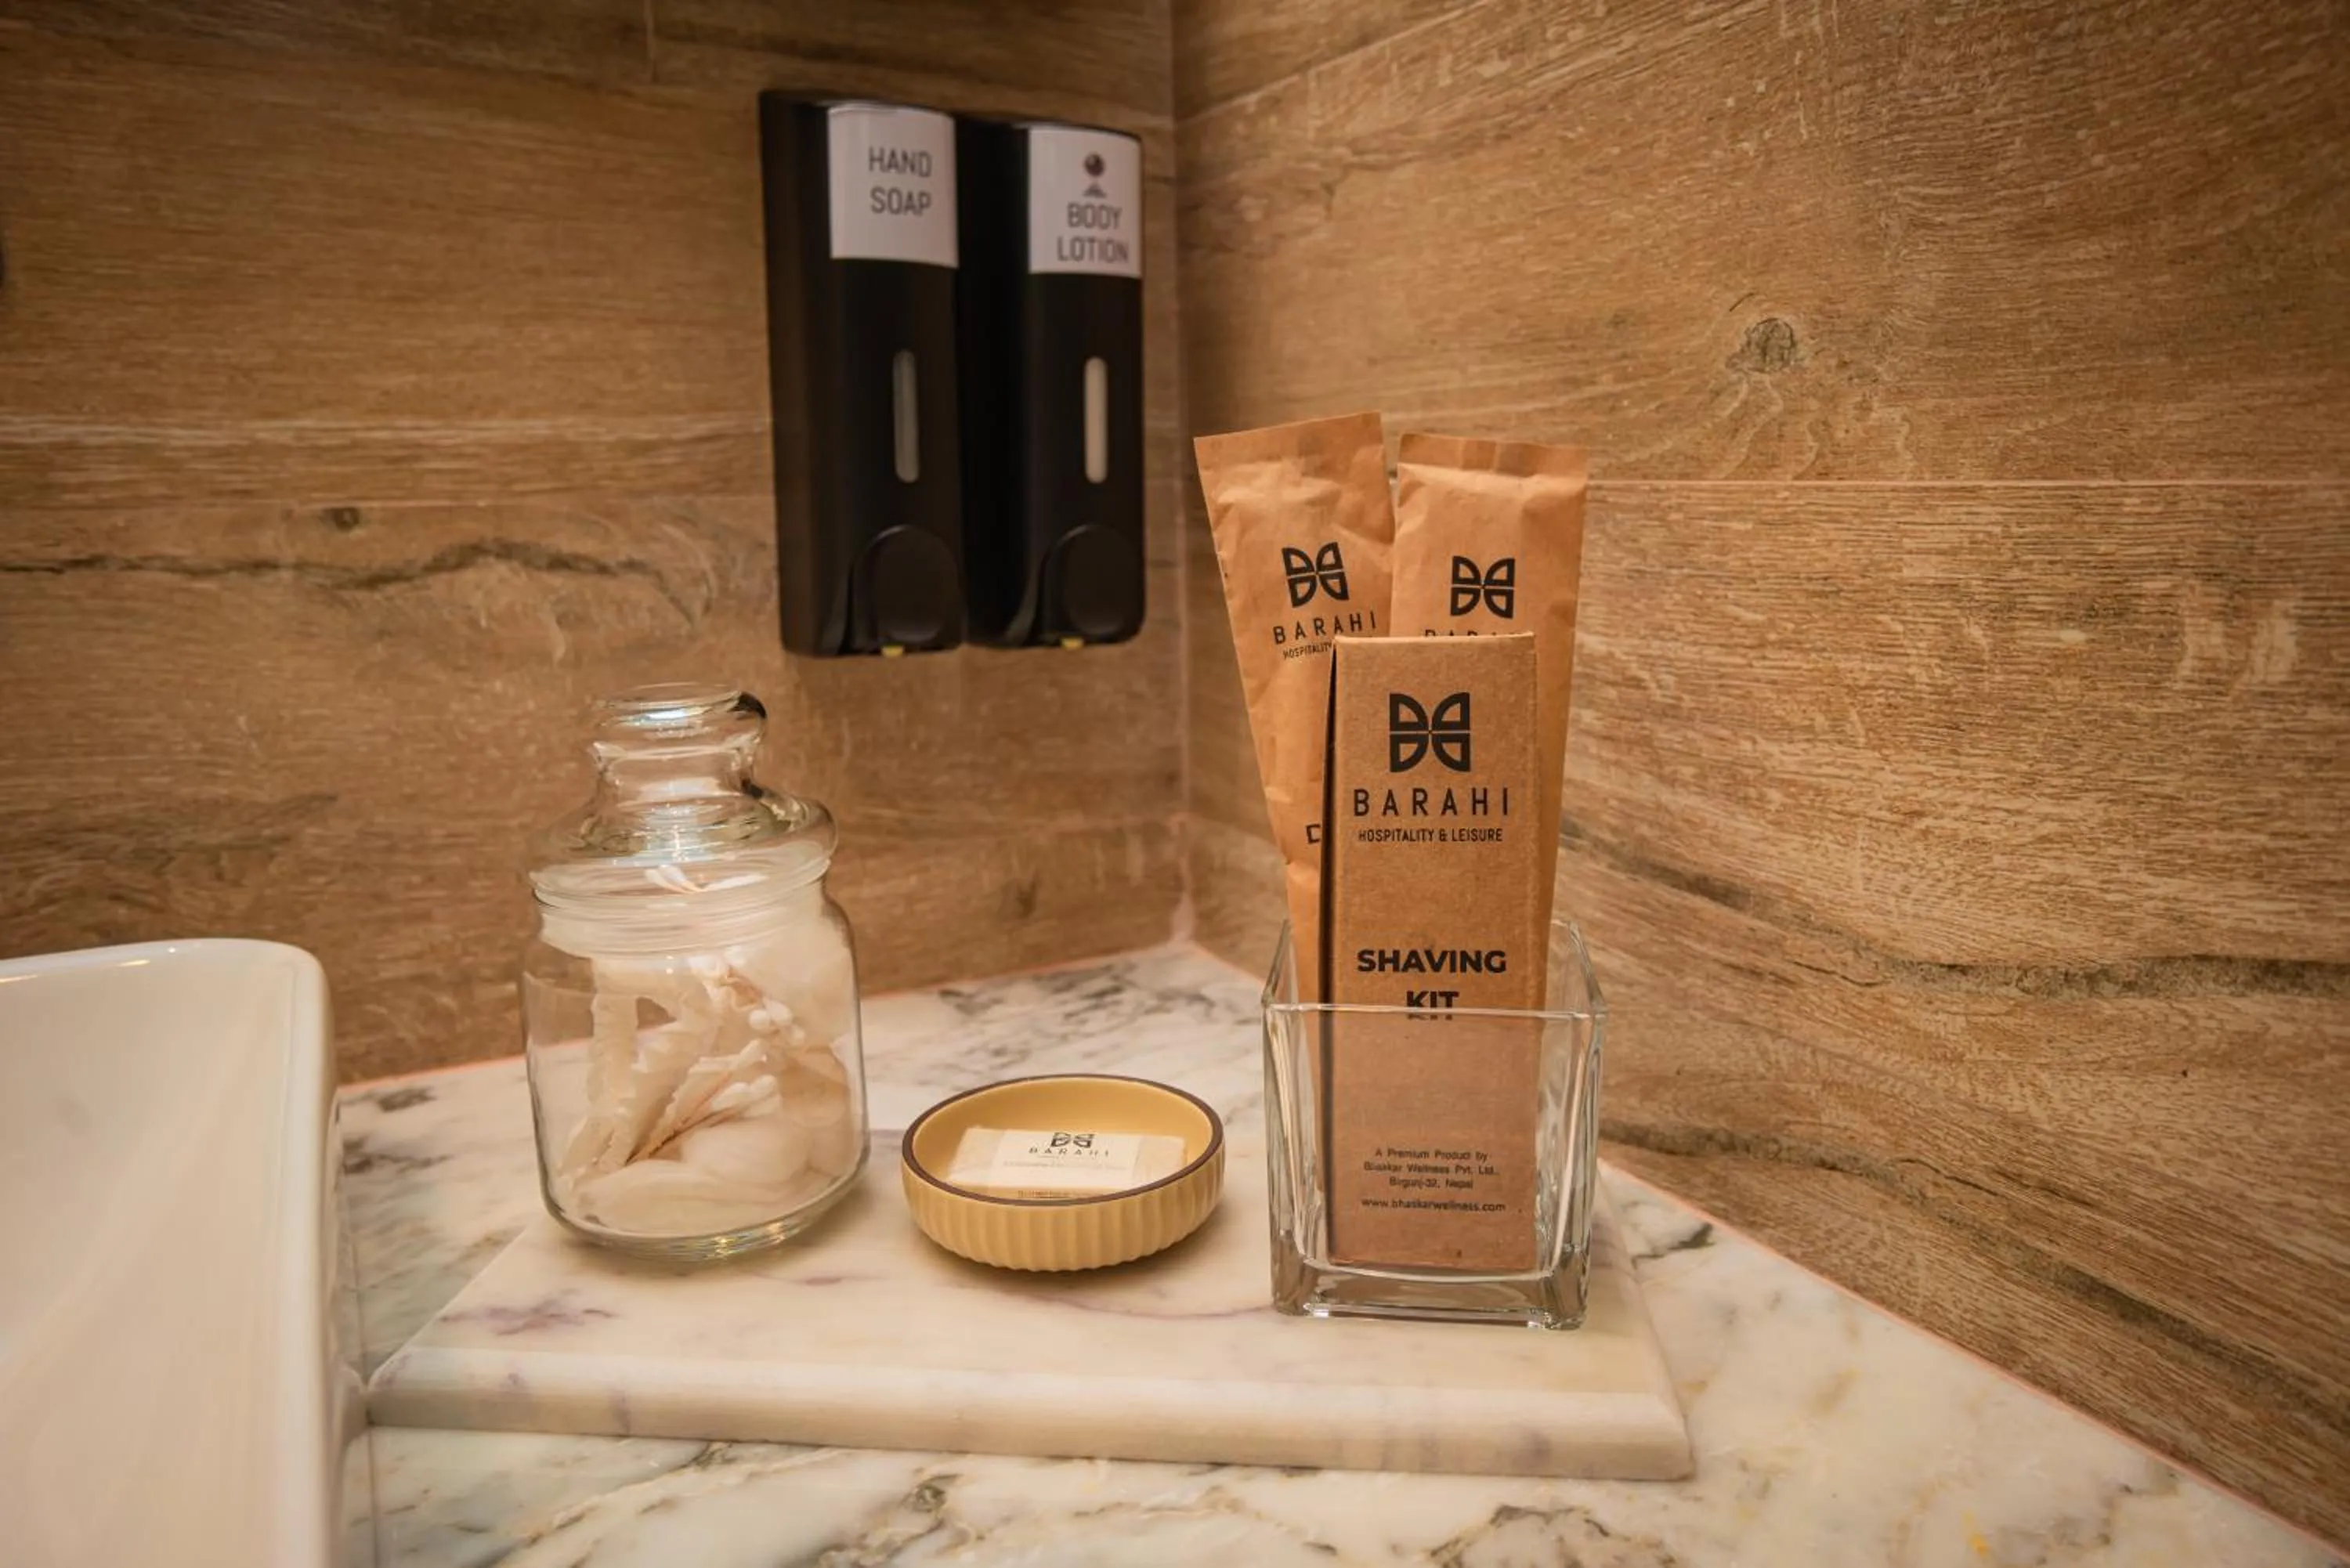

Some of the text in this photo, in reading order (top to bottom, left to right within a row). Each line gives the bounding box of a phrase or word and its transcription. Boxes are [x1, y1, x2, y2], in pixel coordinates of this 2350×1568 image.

[869, 146, 932, 178] HAND
[870, 186, 931, 216] SOAP
[1067, 202, 1122, 230] BODY
[1057, 236, 1129, 263] LOTION
[1273, 611, 1376, 645] BARAHI
[1354, 787, 1508, 817] BARAHI
[1358, 827, 1503, 842] HOSPITALITY & LEISURE
[1357, 948, 1507, 974] SHAVING
[1406, 990, 1459, 1021] KIT
[1375, 1148, 1489, 1163] A Premium Product by
[1408, 1163, 1450, 1174] Wellness
